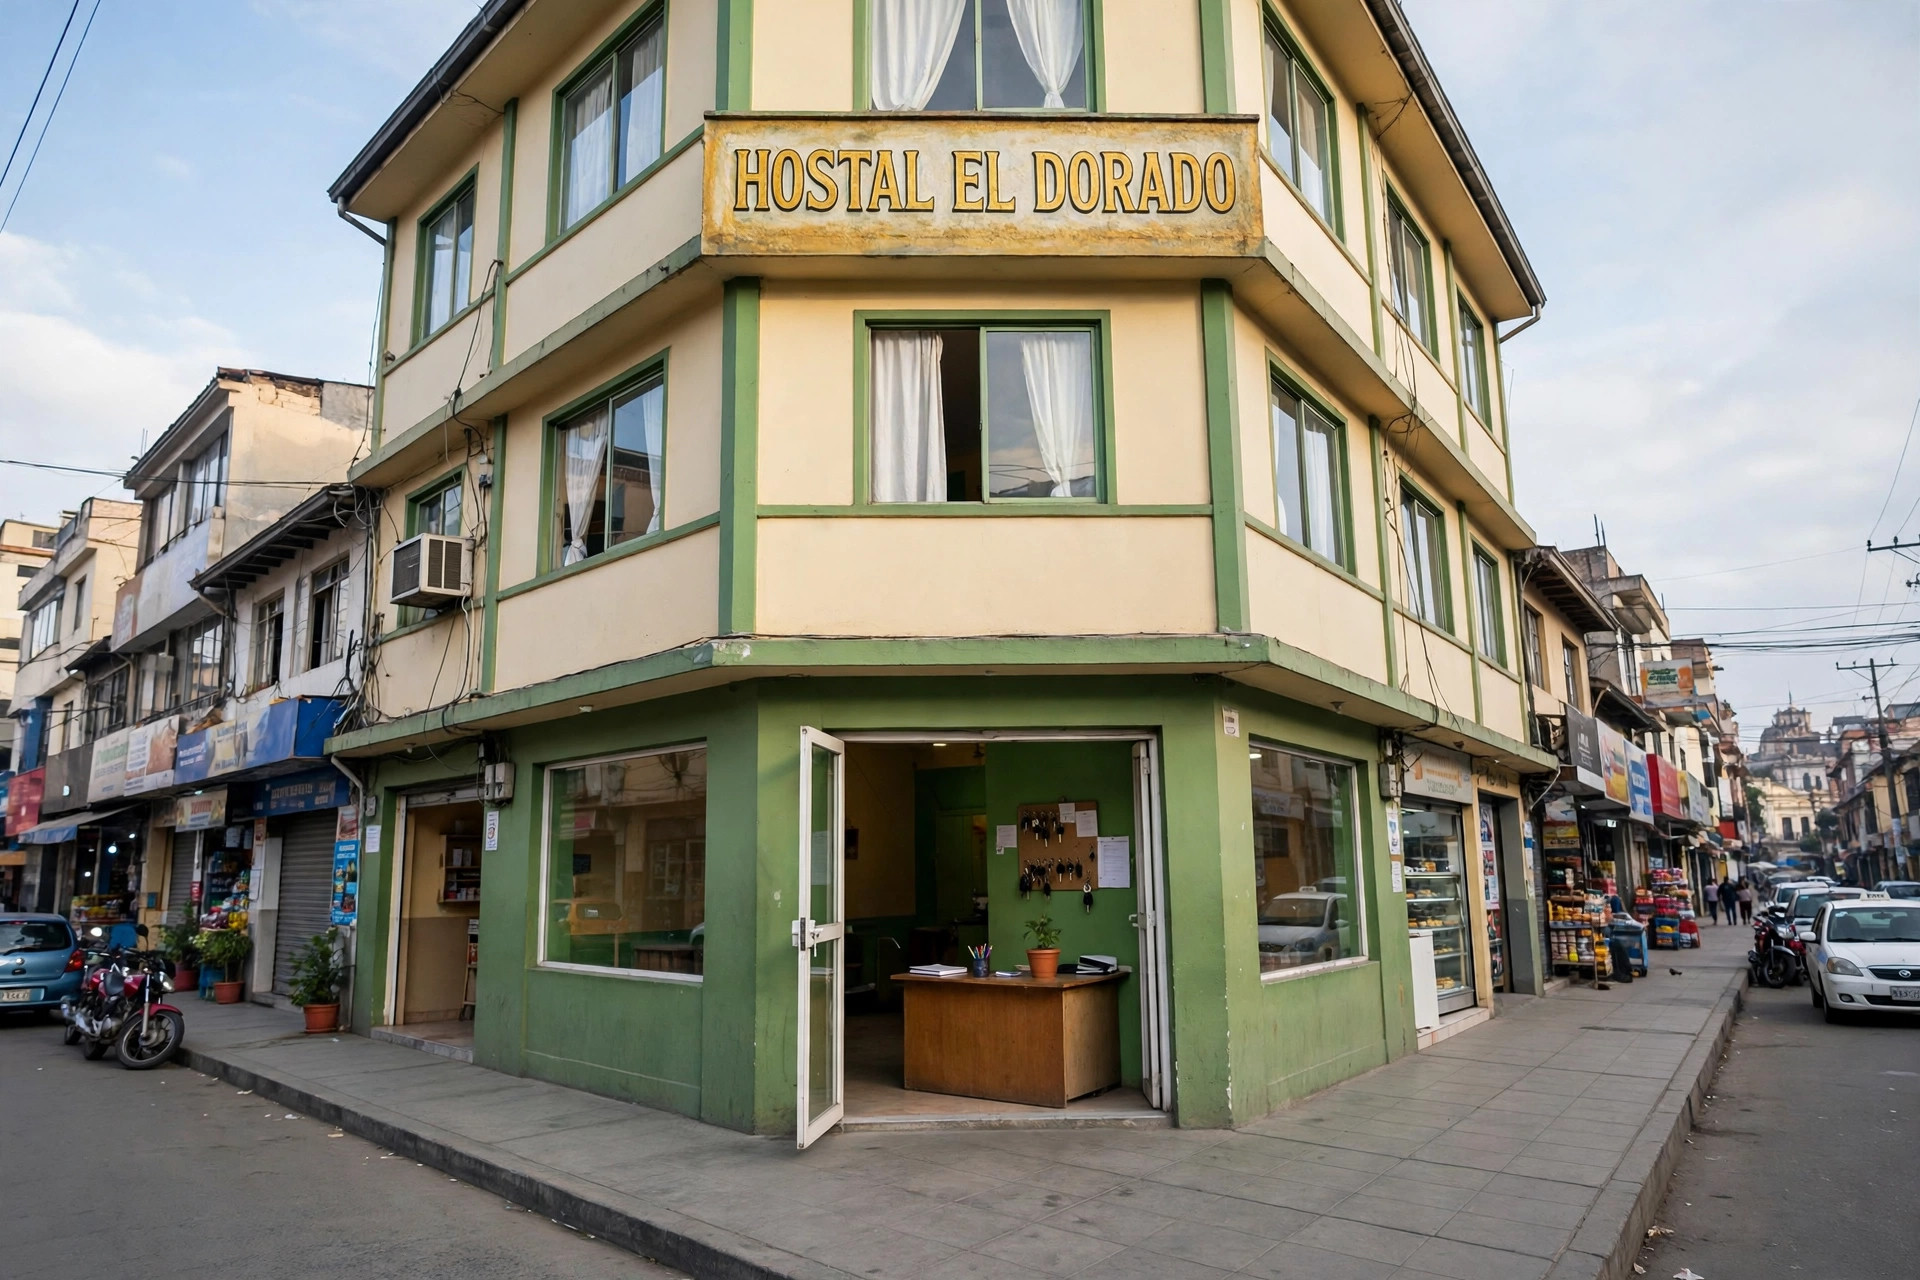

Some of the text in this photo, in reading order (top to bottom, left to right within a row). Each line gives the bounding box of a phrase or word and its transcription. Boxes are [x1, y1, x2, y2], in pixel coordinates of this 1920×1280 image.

[733, 149, 1237, 214] HOSTAL EL DORADO
